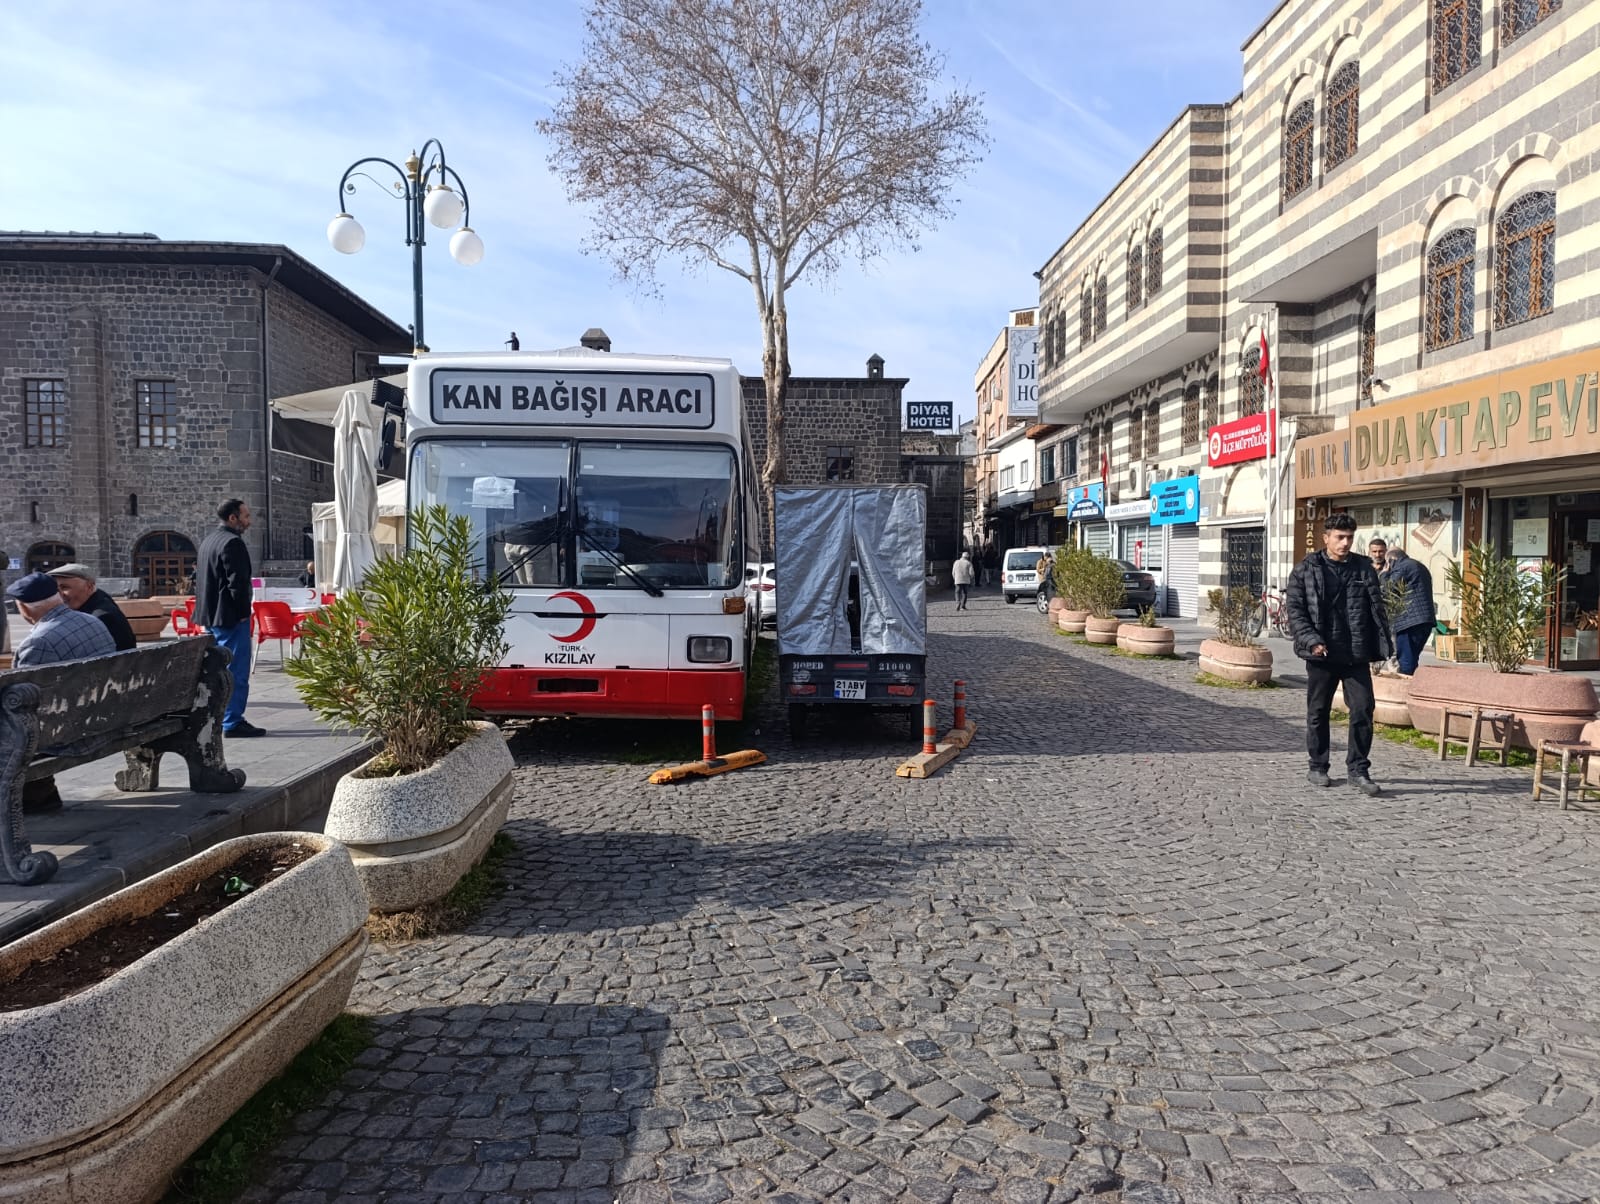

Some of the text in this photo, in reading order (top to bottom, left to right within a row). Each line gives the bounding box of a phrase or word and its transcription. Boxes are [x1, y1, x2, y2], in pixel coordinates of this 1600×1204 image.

[1018, 360, 1039, 380] Dİ
[442, 380, 702, 418] KAN BAĞIŞI ARACI
[1018, 385, 1039, 402] HO
[910, 403, 949, 415] DİYAR
[910, 417, 949, 427] HOTEL
[1355, 415, 1411, 472] DUA
[1300, 447, 1316, 479] DUA
[1321, 443, 1337, 476] HAC
[1296, 506, 1327, 521] DUA
[545, 653, 596, 664] KIZILAY
[836, 681, 865, 689] 21 ABV
[841, 690, 858, 698] 177
